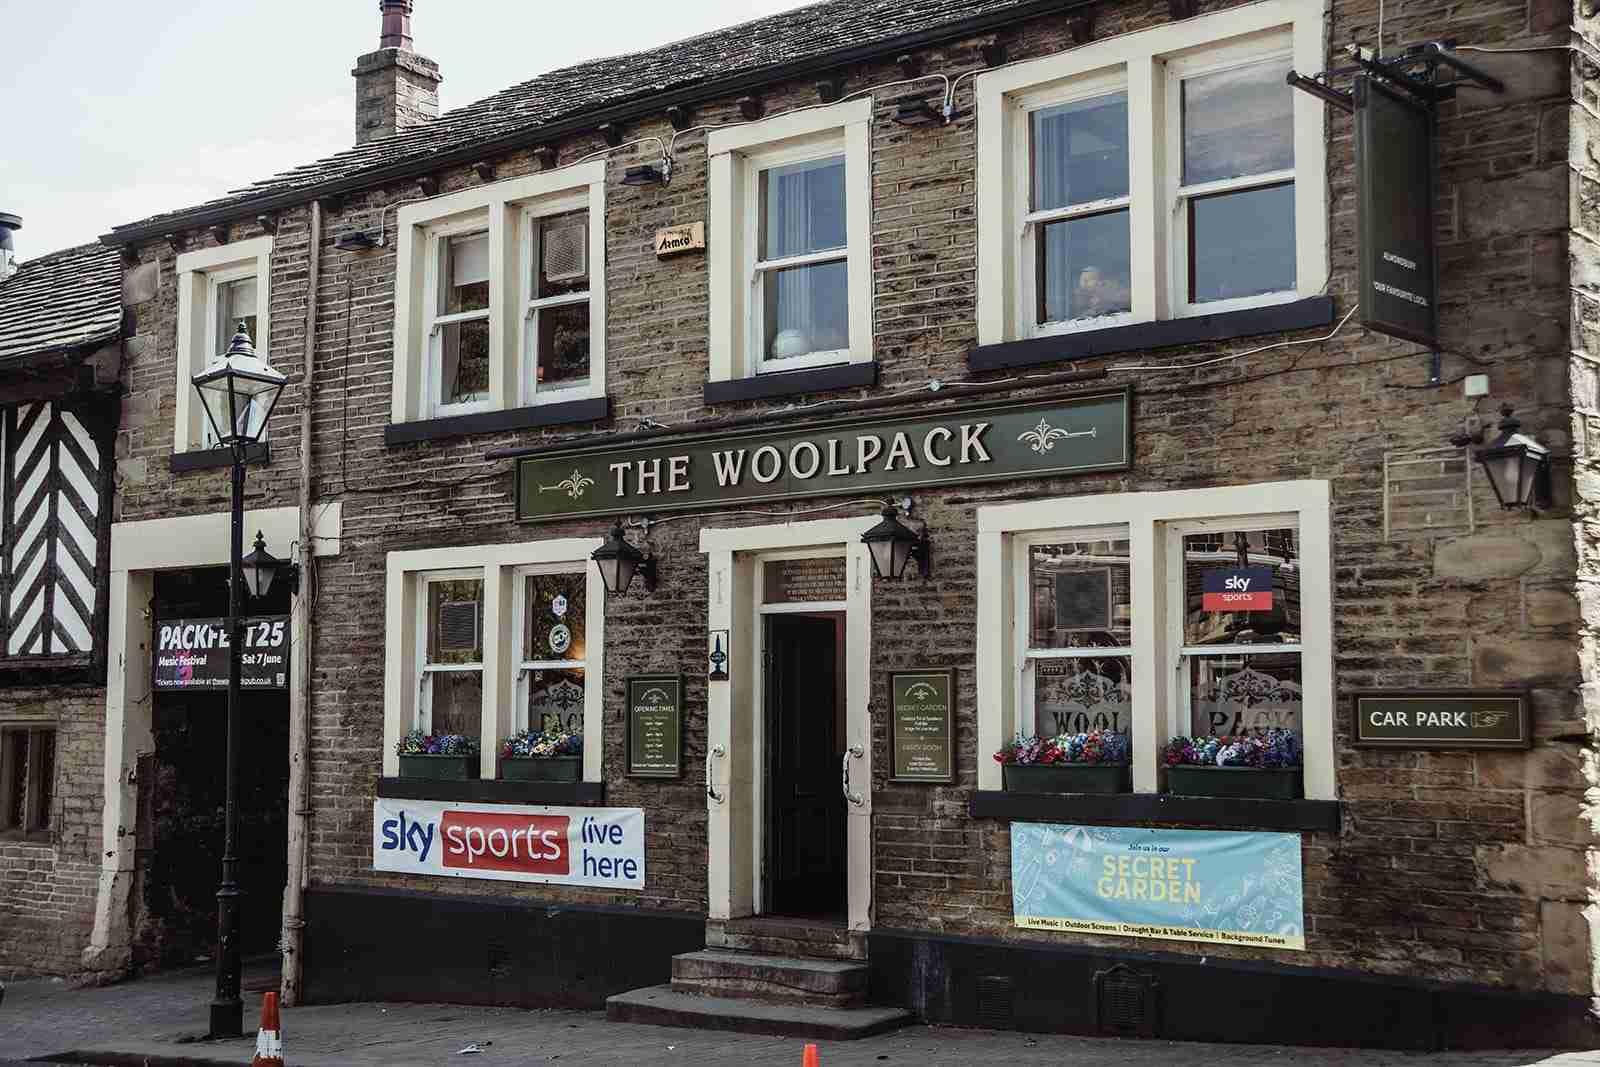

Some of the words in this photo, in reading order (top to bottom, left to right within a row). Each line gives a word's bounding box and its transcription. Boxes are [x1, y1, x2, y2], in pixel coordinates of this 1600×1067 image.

[609, 455, 691, 497] THE
[712, 422, 992, 487] WOOLPACK
[1224, 575, 1251, 592] sky
[1222, 592, 1253, 604] sports
[158, 656, 178, 667] Music
[178, 653, 207, 666] Festival
[242, 653, 255, 664] Sat
[256, 653, 262, 664] 7
[262, 653, 282, 667] June
[1370, 711, 1409, 727] CAR
[1416, 711, 1467, 727] PARK
[382, 810, 435, 862] sky
[446, 823, 561, 864] sports
[581, 816, 624, 845] live
[1128, 843, 1142, 851] Join
[583, 849, 638, 879] here
[1103, 855, 1200, 880] SECRET
[1096, 879, 1201, 903] GARDEN
[1041, 919, 1059, 927] Music
[1065, 921, 1090, 929] Outdoor
[1091, 922, 1117, 931] Screens
[1123, 925, 1149, 935] Draught
[1162, 927, 1169, 935] &
[1170, 928, 1187, 936] Table
[1188, 929, 1214, 938] Service
[1221, 932, 1263, 943] Background
[1264, 936, 1286, 944] Tunes
